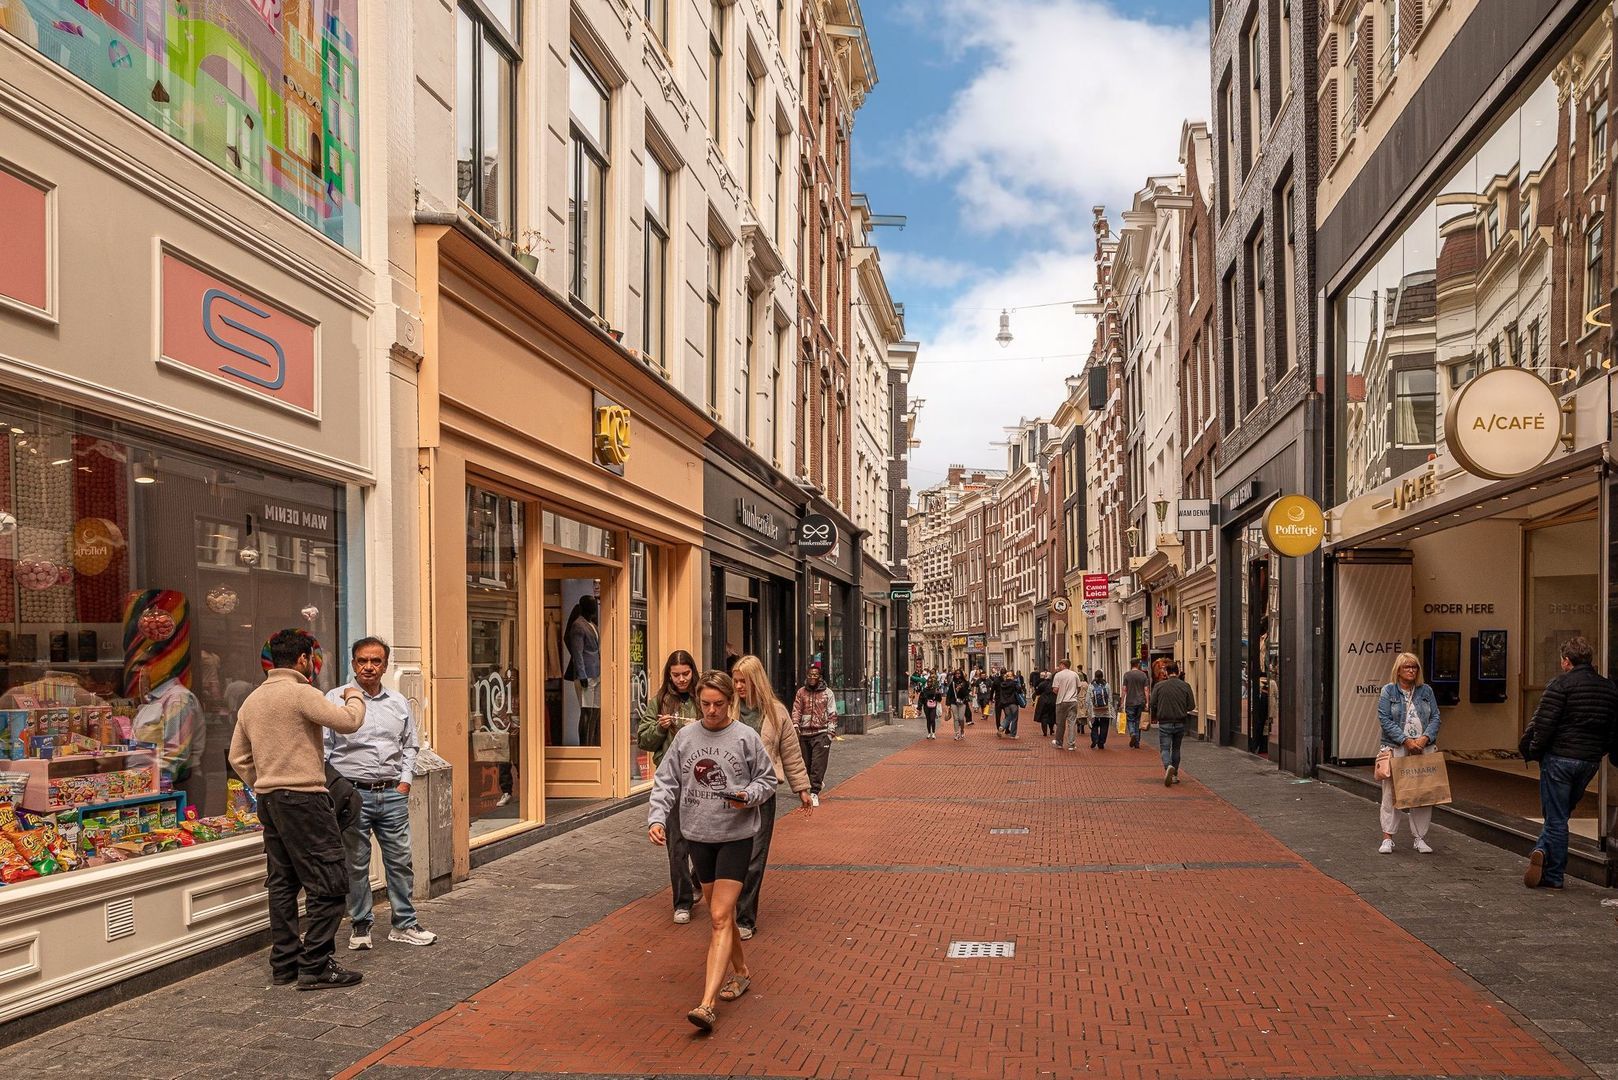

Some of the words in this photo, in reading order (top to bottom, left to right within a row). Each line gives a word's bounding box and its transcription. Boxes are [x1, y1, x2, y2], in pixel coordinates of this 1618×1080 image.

[1472, 412, 1545, 433] A/CAFÉ
[1275, 524, 1318, 537] Poffertje
[1424, 603, 1463, 614] ORDER
[1466, 603, 1494, 614] HERE
[1347, 639, 1402, 656] A/CAFÉ
[1356, 684, 1382, 695] Poffer
[683, 747, 720, 775] VIRGINIA
[723, 750, 743, 777] TECH
[1400, 765, 1438, 777] PRIMARK
